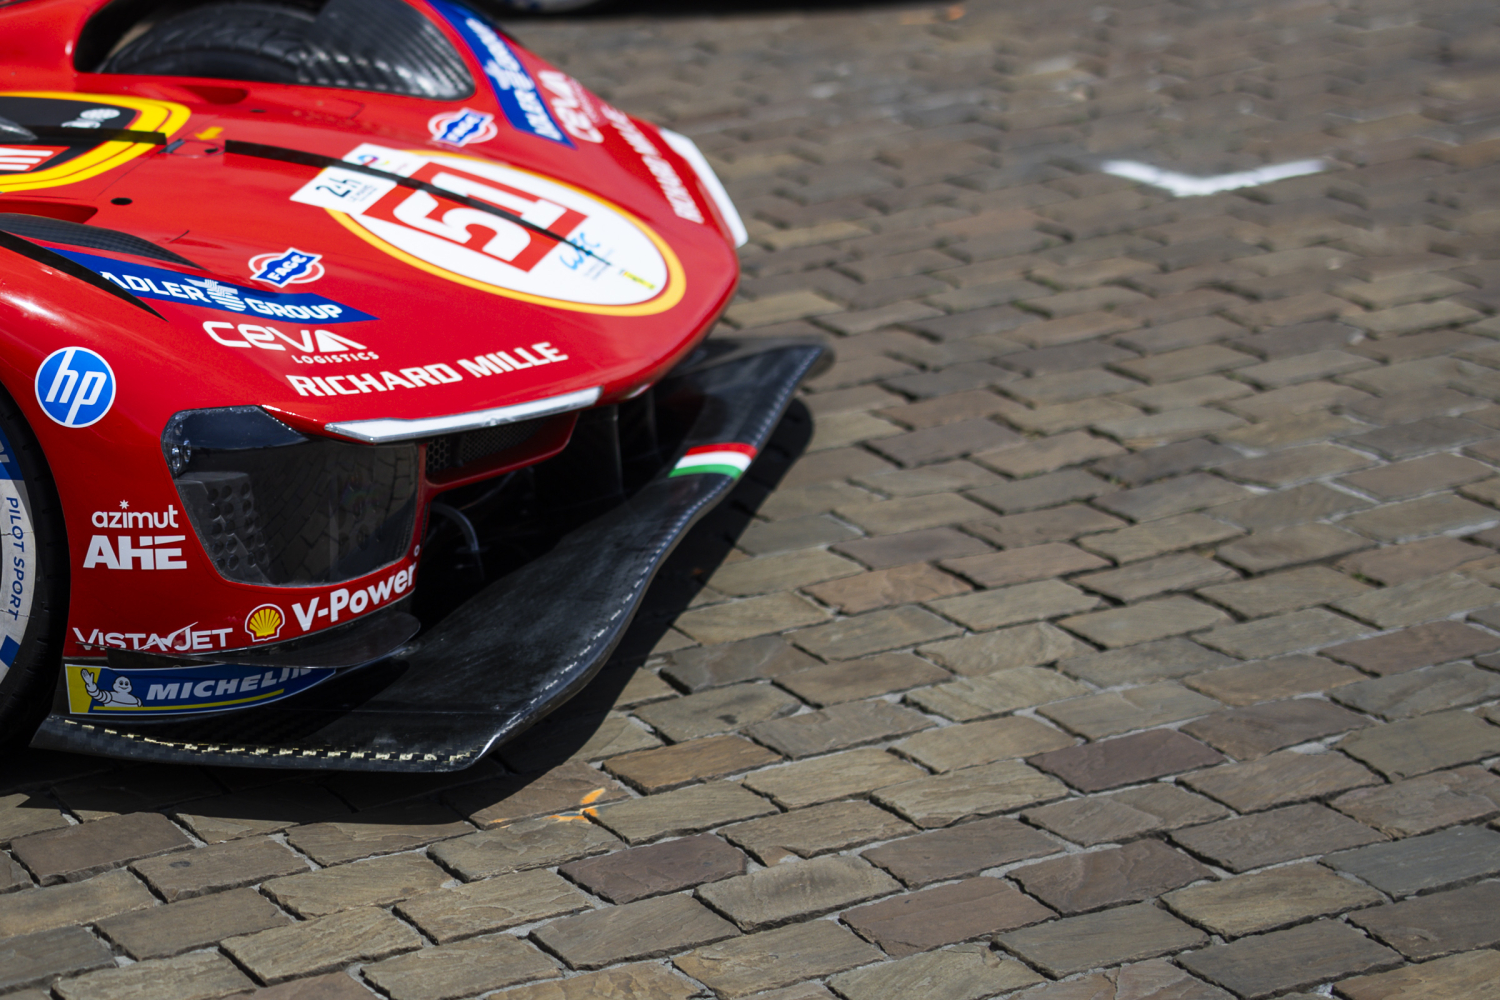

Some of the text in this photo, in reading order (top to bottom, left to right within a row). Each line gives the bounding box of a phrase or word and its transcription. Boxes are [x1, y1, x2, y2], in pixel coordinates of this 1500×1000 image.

[393, 171, 567, 262] 51
[100, 271, 342, 320] ADLER GROUP
[203, 320, 367, 353] CEVA
[291, 350, 379, 365] LOGISTICS
[46, 349, 107, 426] hp
[285, 341, 570, 398] RICHARD MILLE
[92, 504, 179, 529] azimut
[6, 495, 26, 621] PILOT SPORT
[83, 535, 187, 570] AHE
[292, 567, 415, 632] V-Power
[146, 667, 313, 701] MICHELIN
